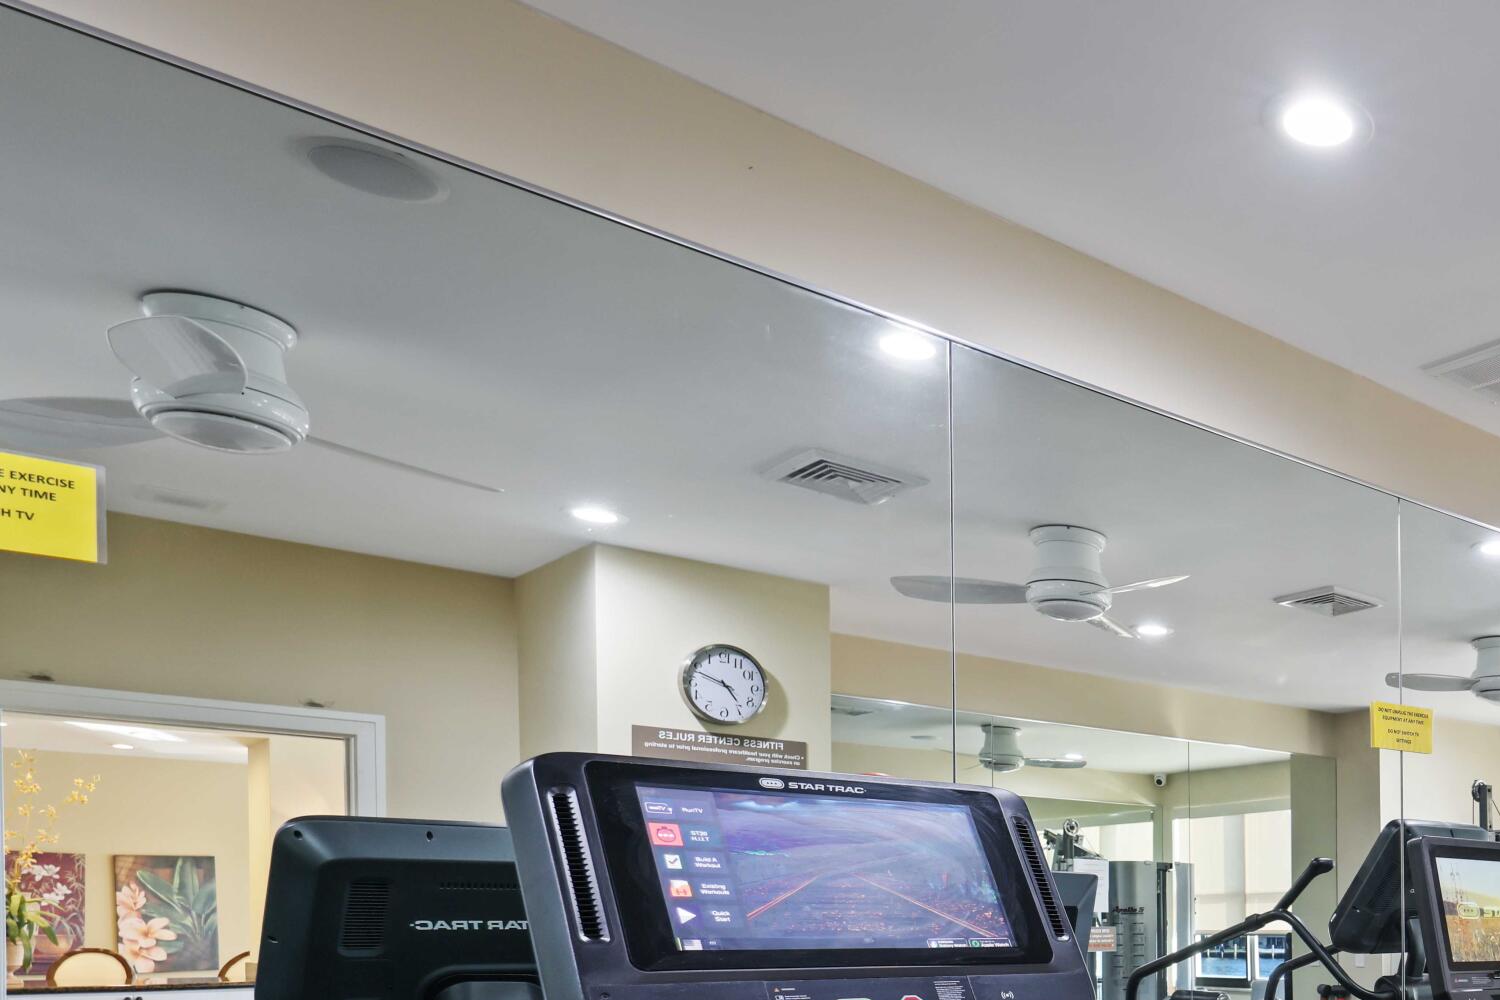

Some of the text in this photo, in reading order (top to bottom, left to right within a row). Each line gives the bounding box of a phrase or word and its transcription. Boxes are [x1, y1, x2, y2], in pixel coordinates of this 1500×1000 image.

[9, 470, 76, 489] EXERCISE
[20, 487, 57, 502] TIME
[15, 510, 35, 521] TV
[788, 781, 865, 794] STAR TRAC
